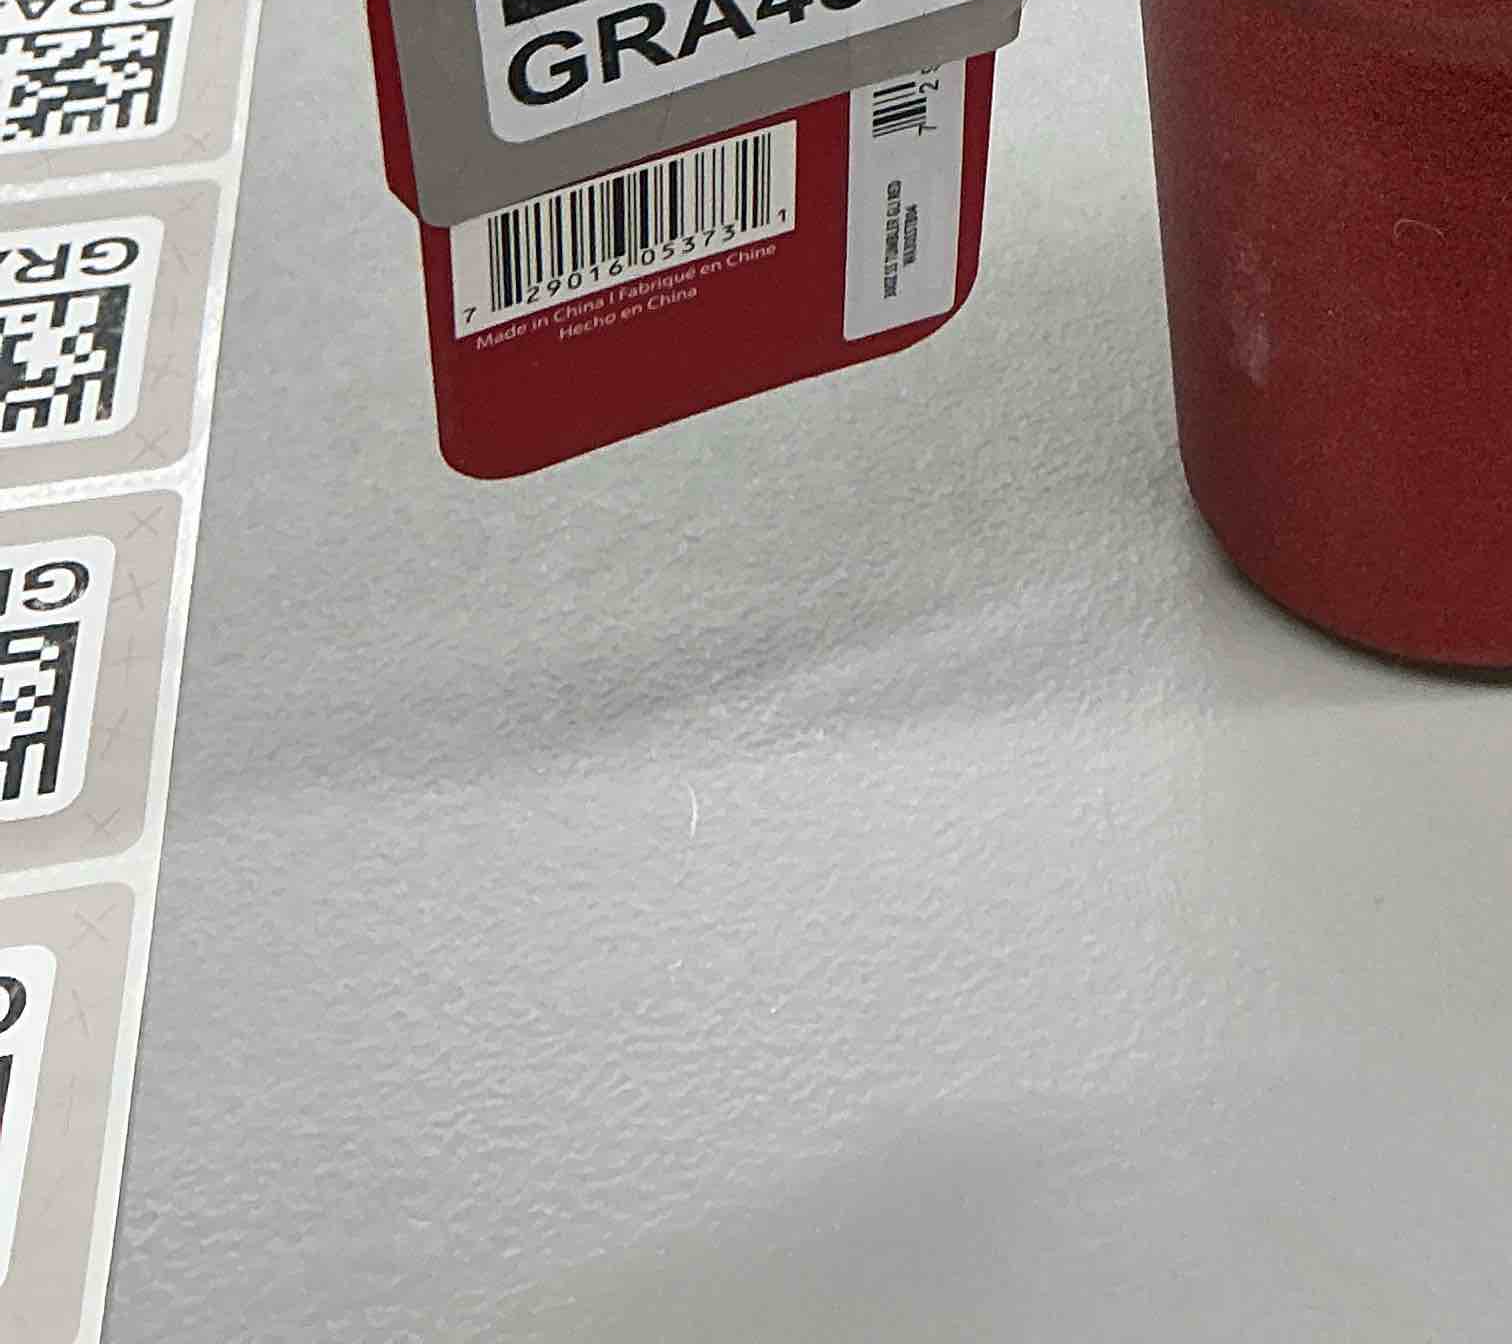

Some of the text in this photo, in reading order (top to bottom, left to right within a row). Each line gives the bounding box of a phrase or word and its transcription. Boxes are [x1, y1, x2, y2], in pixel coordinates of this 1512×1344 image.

[0, 237, 139, 283] GR
[464, 209, 787, 324] 7 29016 05373 1
[476, 323, 527, 351] Made
[531, 315, 549, 330] in
[554, 298, 605, 323] China
[619, 264, 696, 304] Fabriqué
[700, 259, 722, 275] en
[726, 243, 777, 269] Chine
[560, 286, 697, 341] Hecho en China
